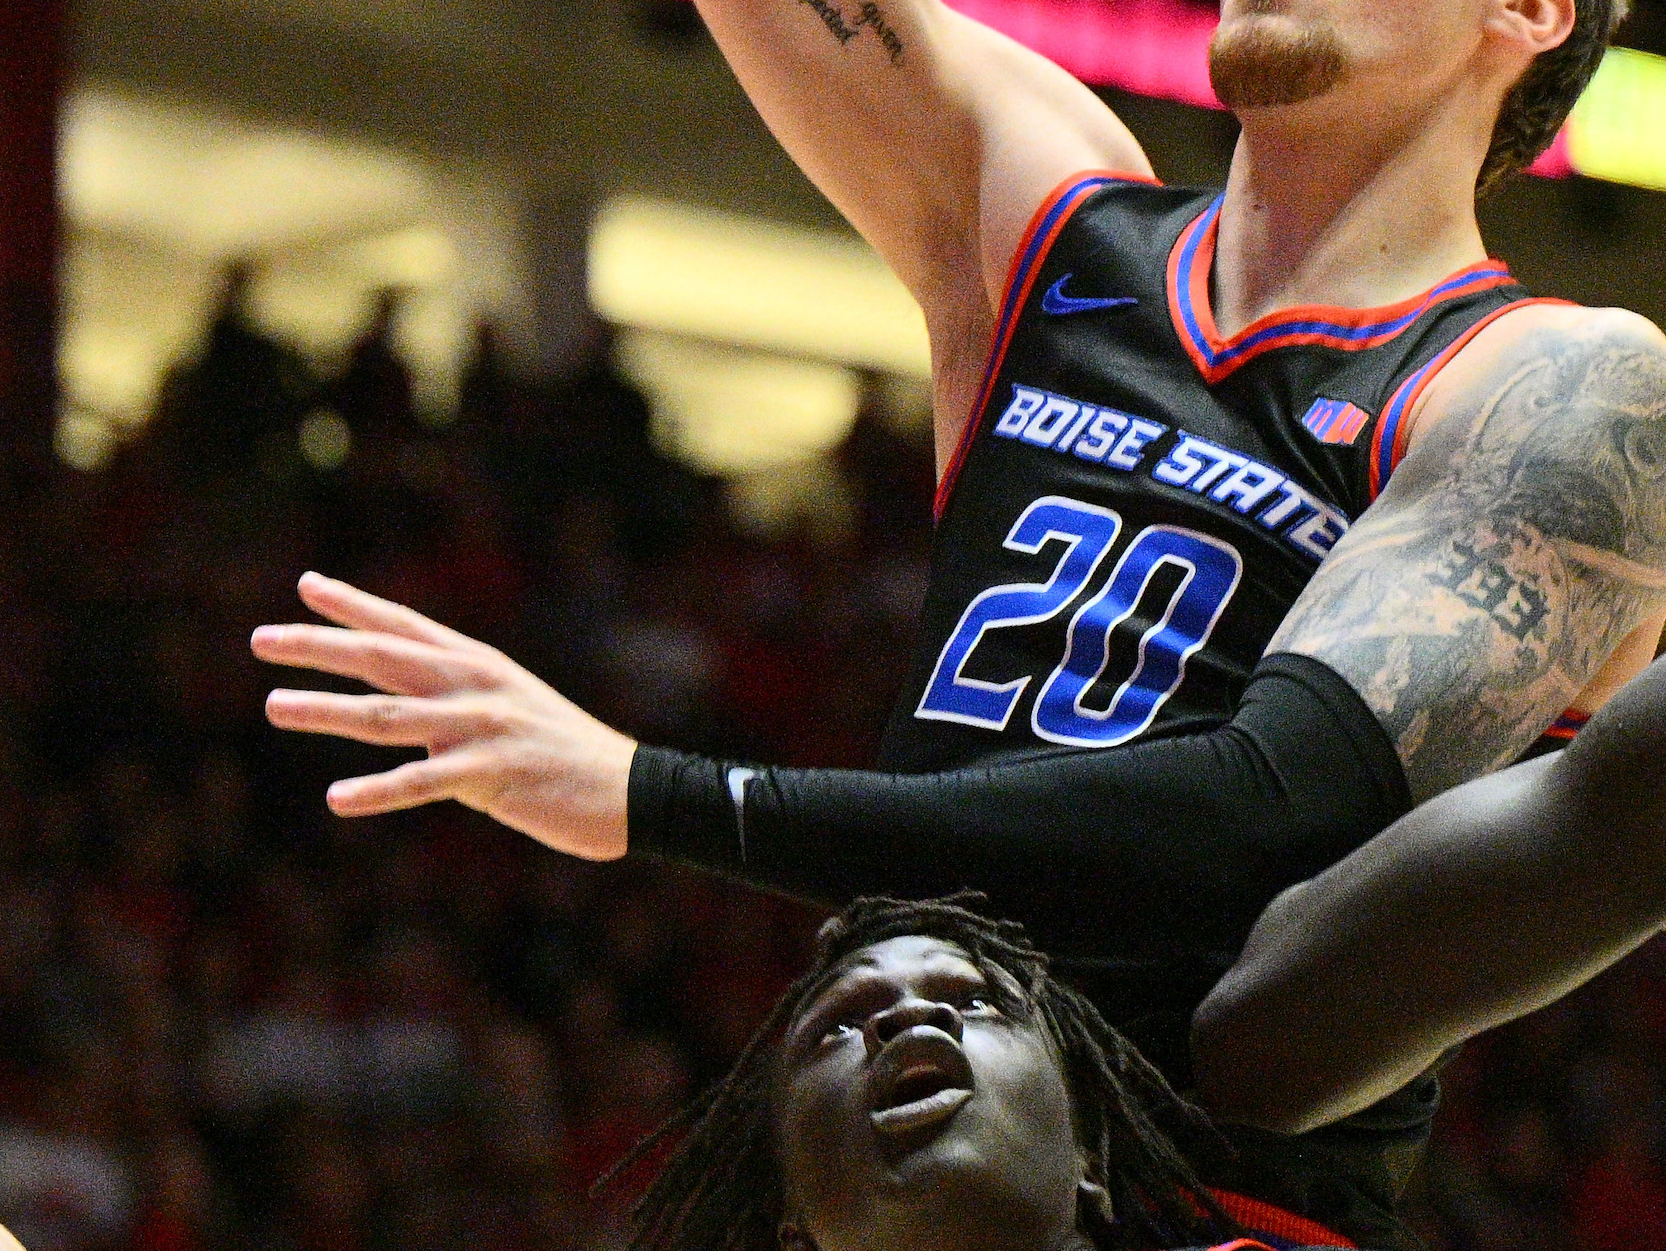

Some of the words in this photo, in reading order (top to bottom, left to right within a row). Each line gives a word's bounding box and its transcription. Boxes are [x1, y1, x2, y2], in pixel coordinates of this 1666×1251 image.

[992, 383, 1168, 471] BOISE
[1151, 430, 1351, 561] STATE
[914, 494, 1243, 748] 20
